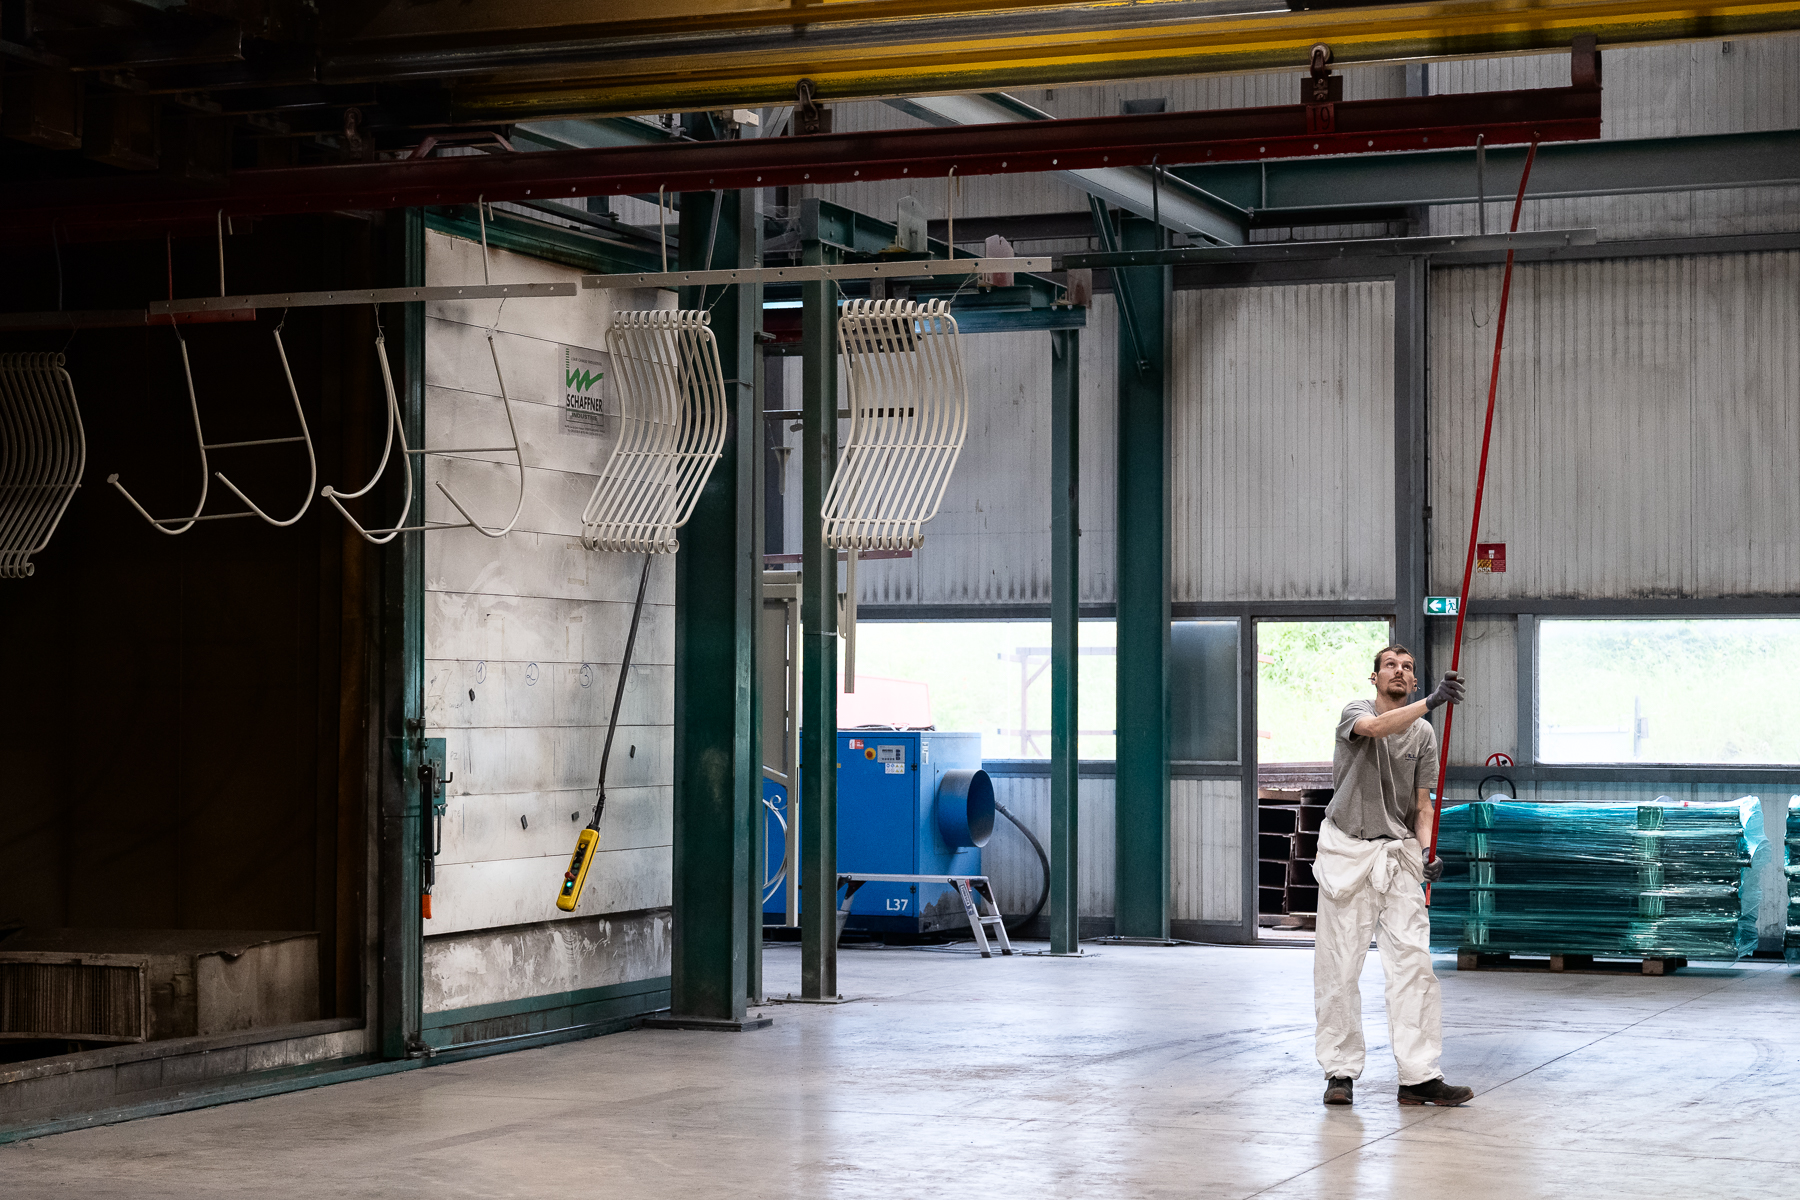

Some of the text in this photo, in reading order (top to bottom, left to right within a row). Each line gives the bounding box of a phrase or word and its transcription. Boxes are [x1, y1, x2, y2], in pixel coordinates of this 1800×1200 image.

[1312, 106, 1330, 131] 19
[566, 393, 603, 412] SCHAFFNER
[526, 663, 537, 683] 2
[580, 664, 591, 688] 3
[886, 898, 908, 911] L37
